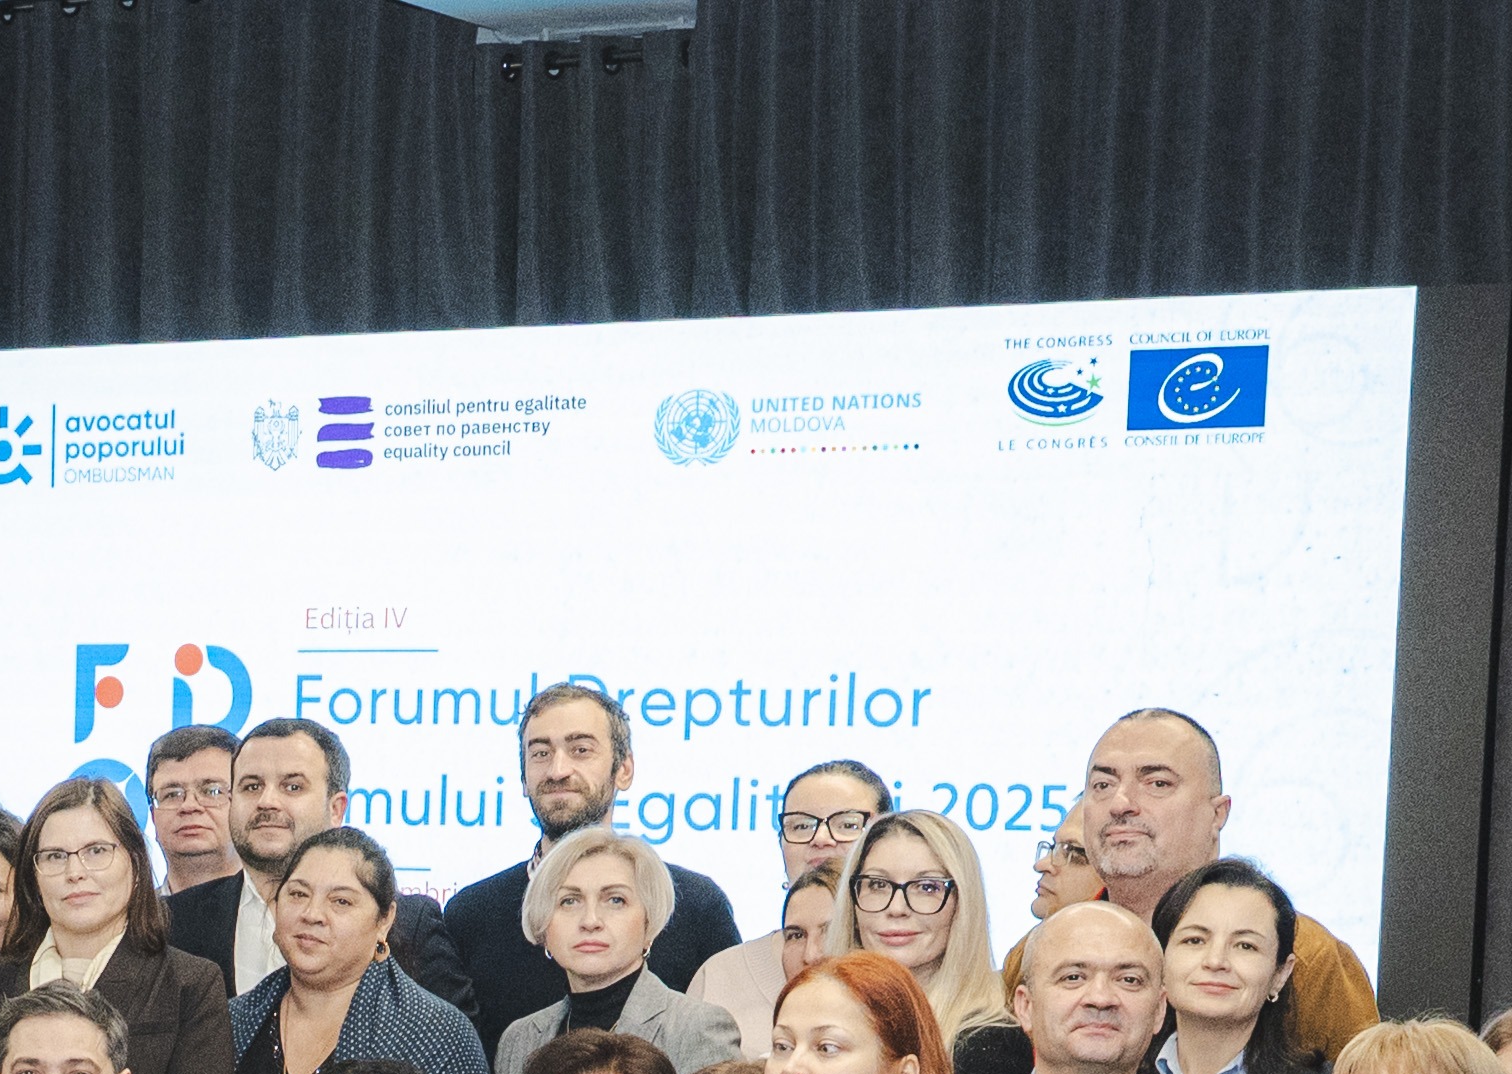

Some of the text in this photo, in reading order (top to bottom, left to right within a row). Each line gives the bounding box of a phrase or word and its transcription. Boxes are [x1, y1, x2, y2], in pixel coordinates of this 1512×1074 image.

[1004, 334, 1113, 350] THE CONGRESS
[1129, 331, 1192, 345] COUNCIL
[1196, 330, 1213, 342] OF
[384, 394, 588, 417] consiliul pentru egalitate
[751, 392, 922, 414] UNITED NATIONS
[64, 408, 176, 433] avocatul
[384, 419, 551, 439] совет по равенству
[750, 416, 846, 433] MOLDOVA
[65, 432, 185, 463] poporului
[384, 440, 511, 461] equality council
[998, 439, 1016, 452] LE
[1125, 434, 1178, 448] CONSEIL
[1184, 434, 1200, 446] DE
[63, 465, 175, 484] OMBUDSMAN
[304, 606, 408, 636] Ediția IV
[344, 774, 504, 828] mului
[932, 782, 1069, 833] 2025
